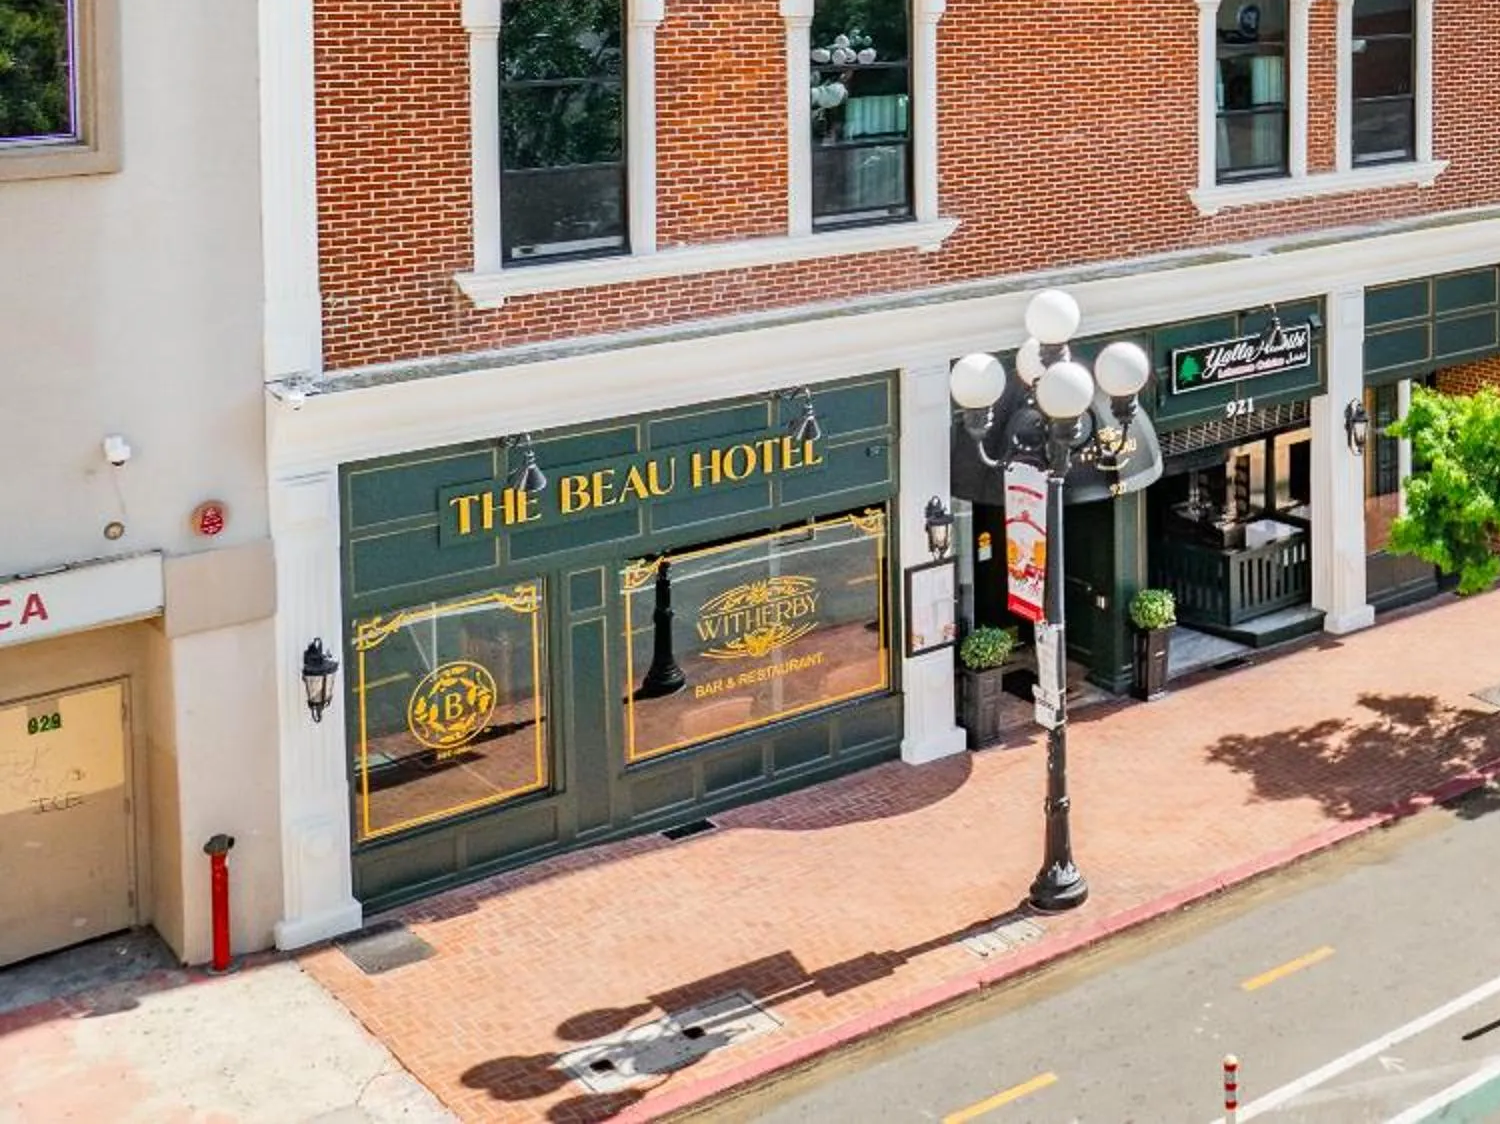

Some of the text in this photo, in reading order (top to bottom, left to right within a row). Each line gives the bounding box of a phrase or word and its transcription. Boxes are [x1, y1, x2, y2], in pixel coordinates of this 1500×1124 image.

[1226, 398, 1254, 418] 921
[449, 435, 824, 535] THE BEAU HOTEL
[696, 591, 821, 642] WITHERBY
[695, 651, 826, 699] BAR & RESTAURANT
[445, 692, 464, 720] B
